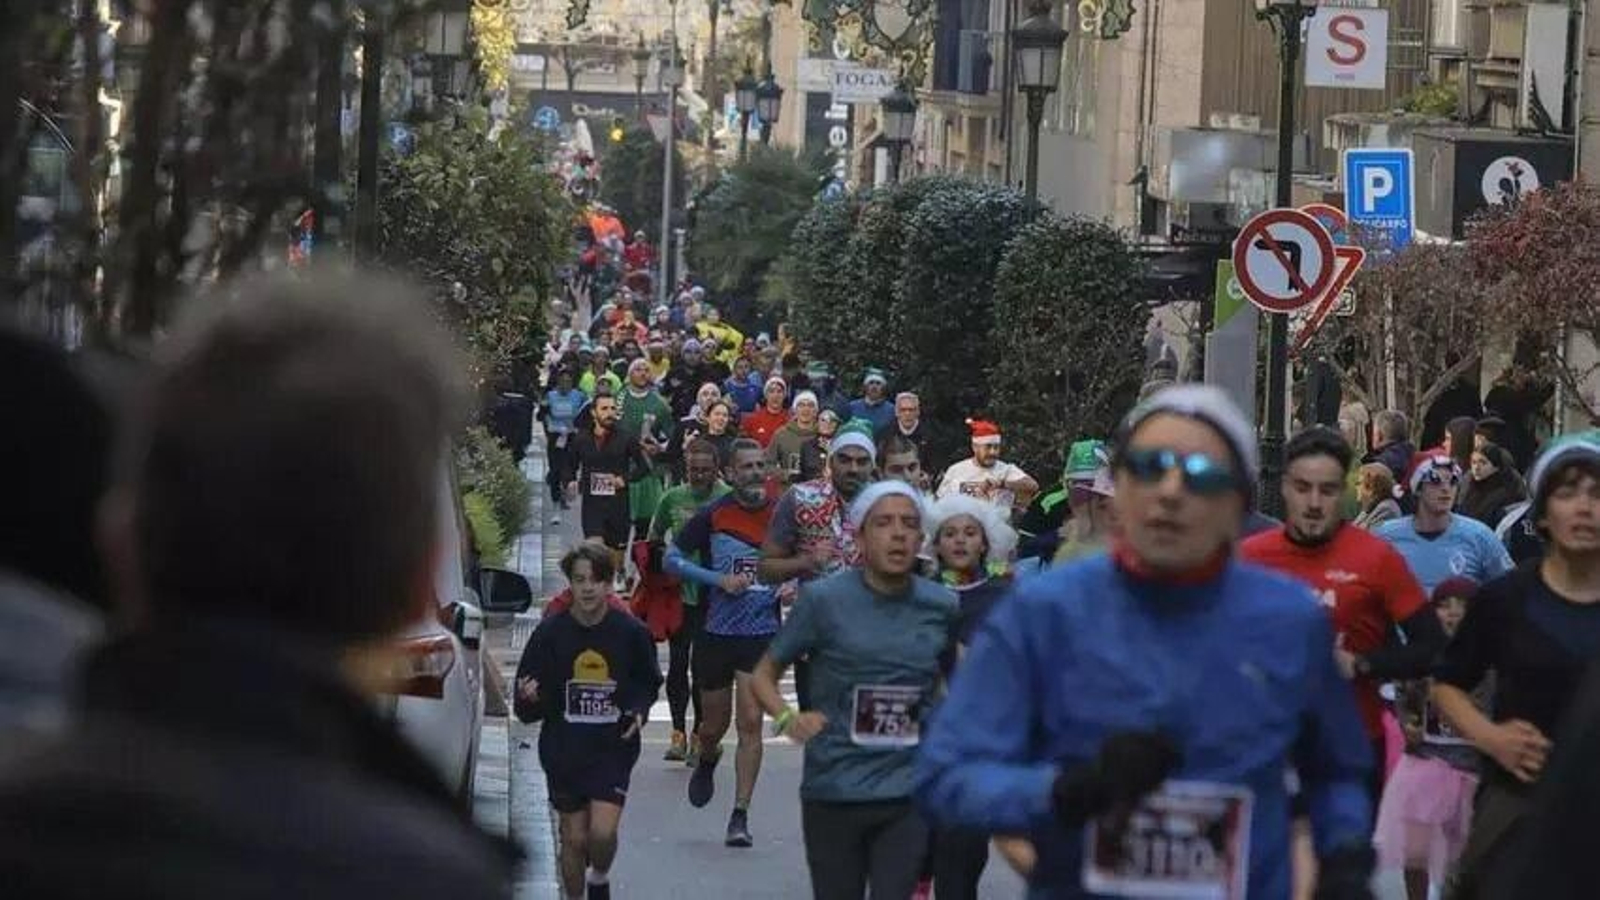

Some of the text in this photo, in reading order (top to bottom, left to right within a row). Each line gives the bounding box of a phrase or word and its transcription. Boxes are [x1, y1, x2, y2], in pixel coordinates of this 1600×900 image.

[1326, 15, 1367, 66] S
[1363, 166, 1393, 212] P
[579, 699, 612, 715] 1195
